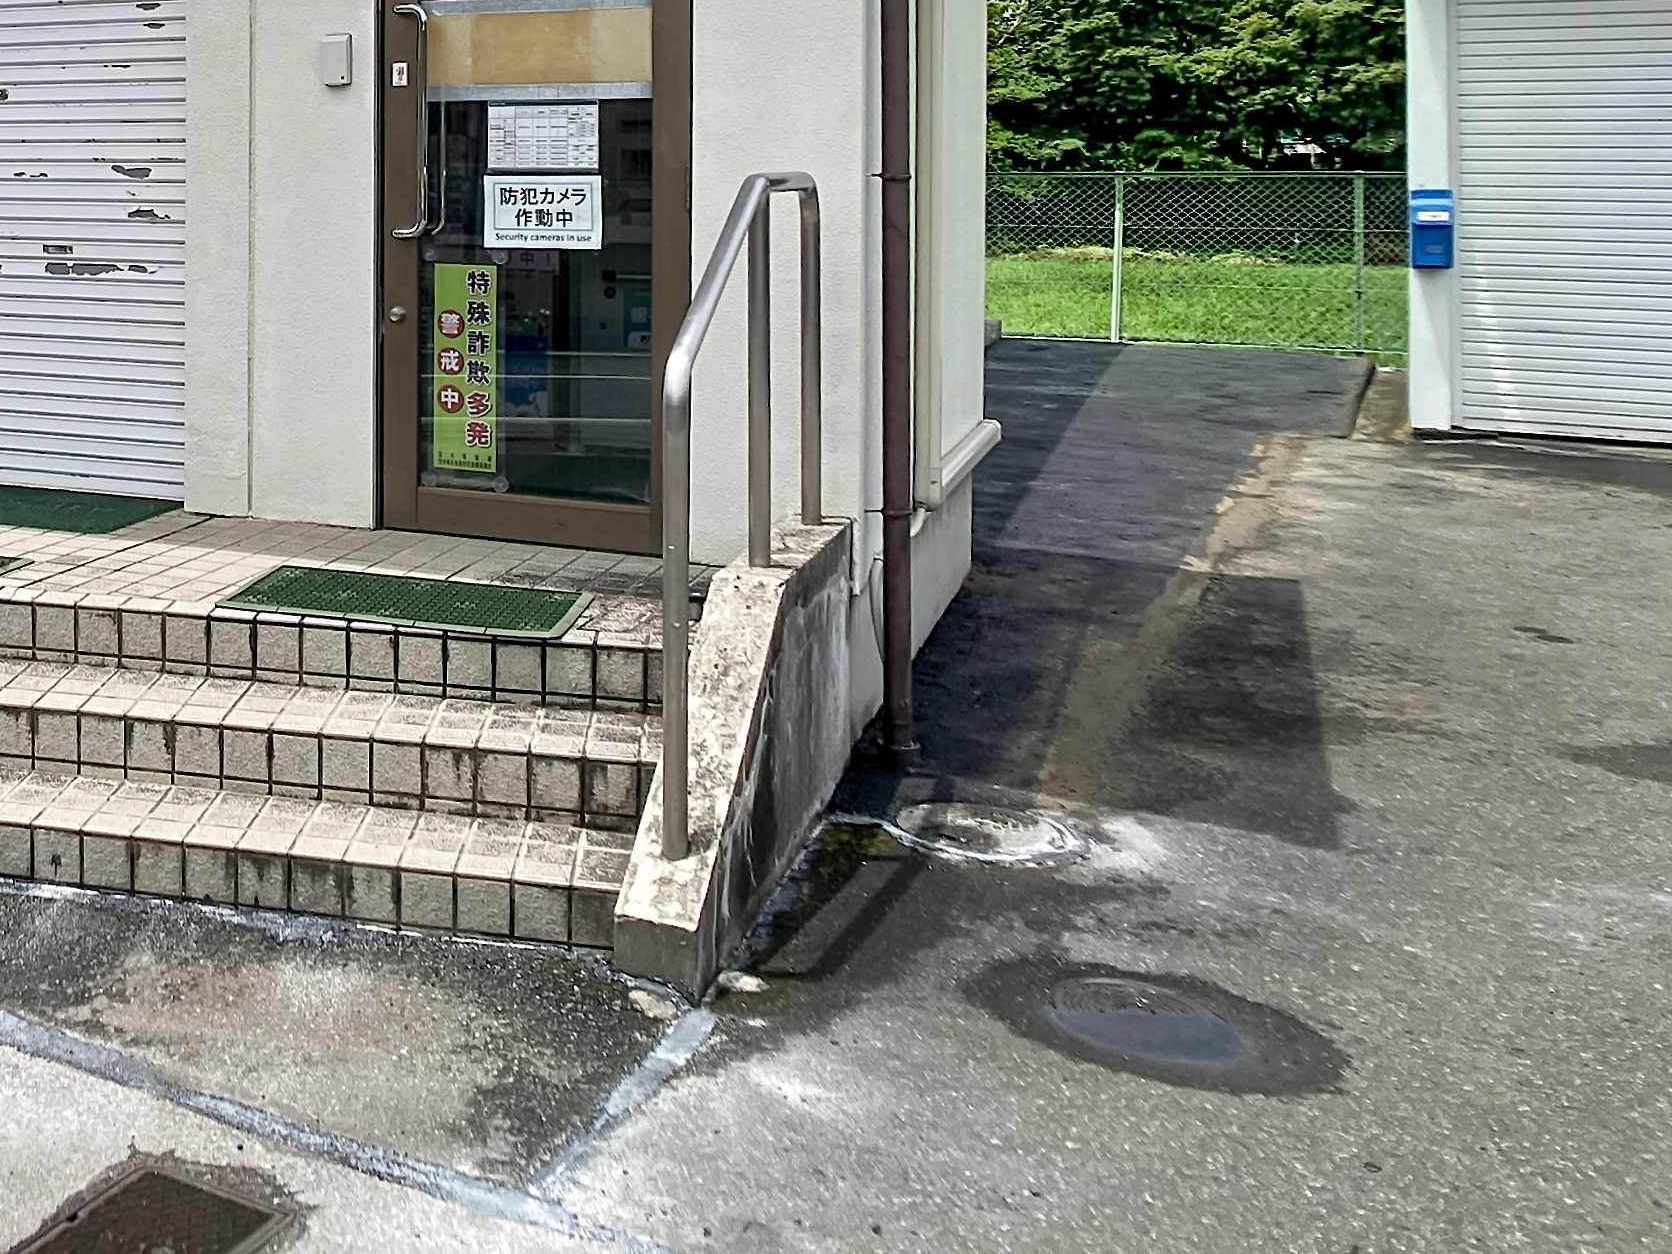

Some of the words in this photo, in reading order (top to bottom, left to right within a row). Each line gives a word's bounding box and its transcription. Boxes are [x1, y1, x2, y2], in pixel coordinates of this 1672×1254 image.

[499, 187, 587, 206] 防犯カメラ
[515, 208, 573, 228] 作動中
[495, 232, 528, 243] Security
[529, 233, 565, 243] cameras
[566, 233, 575, 242] in
[577, 234, 592, 243] use
[439, 312, 462, 410] 警戒中
[465, 269, 493, 448] 特殊詐欺多発
